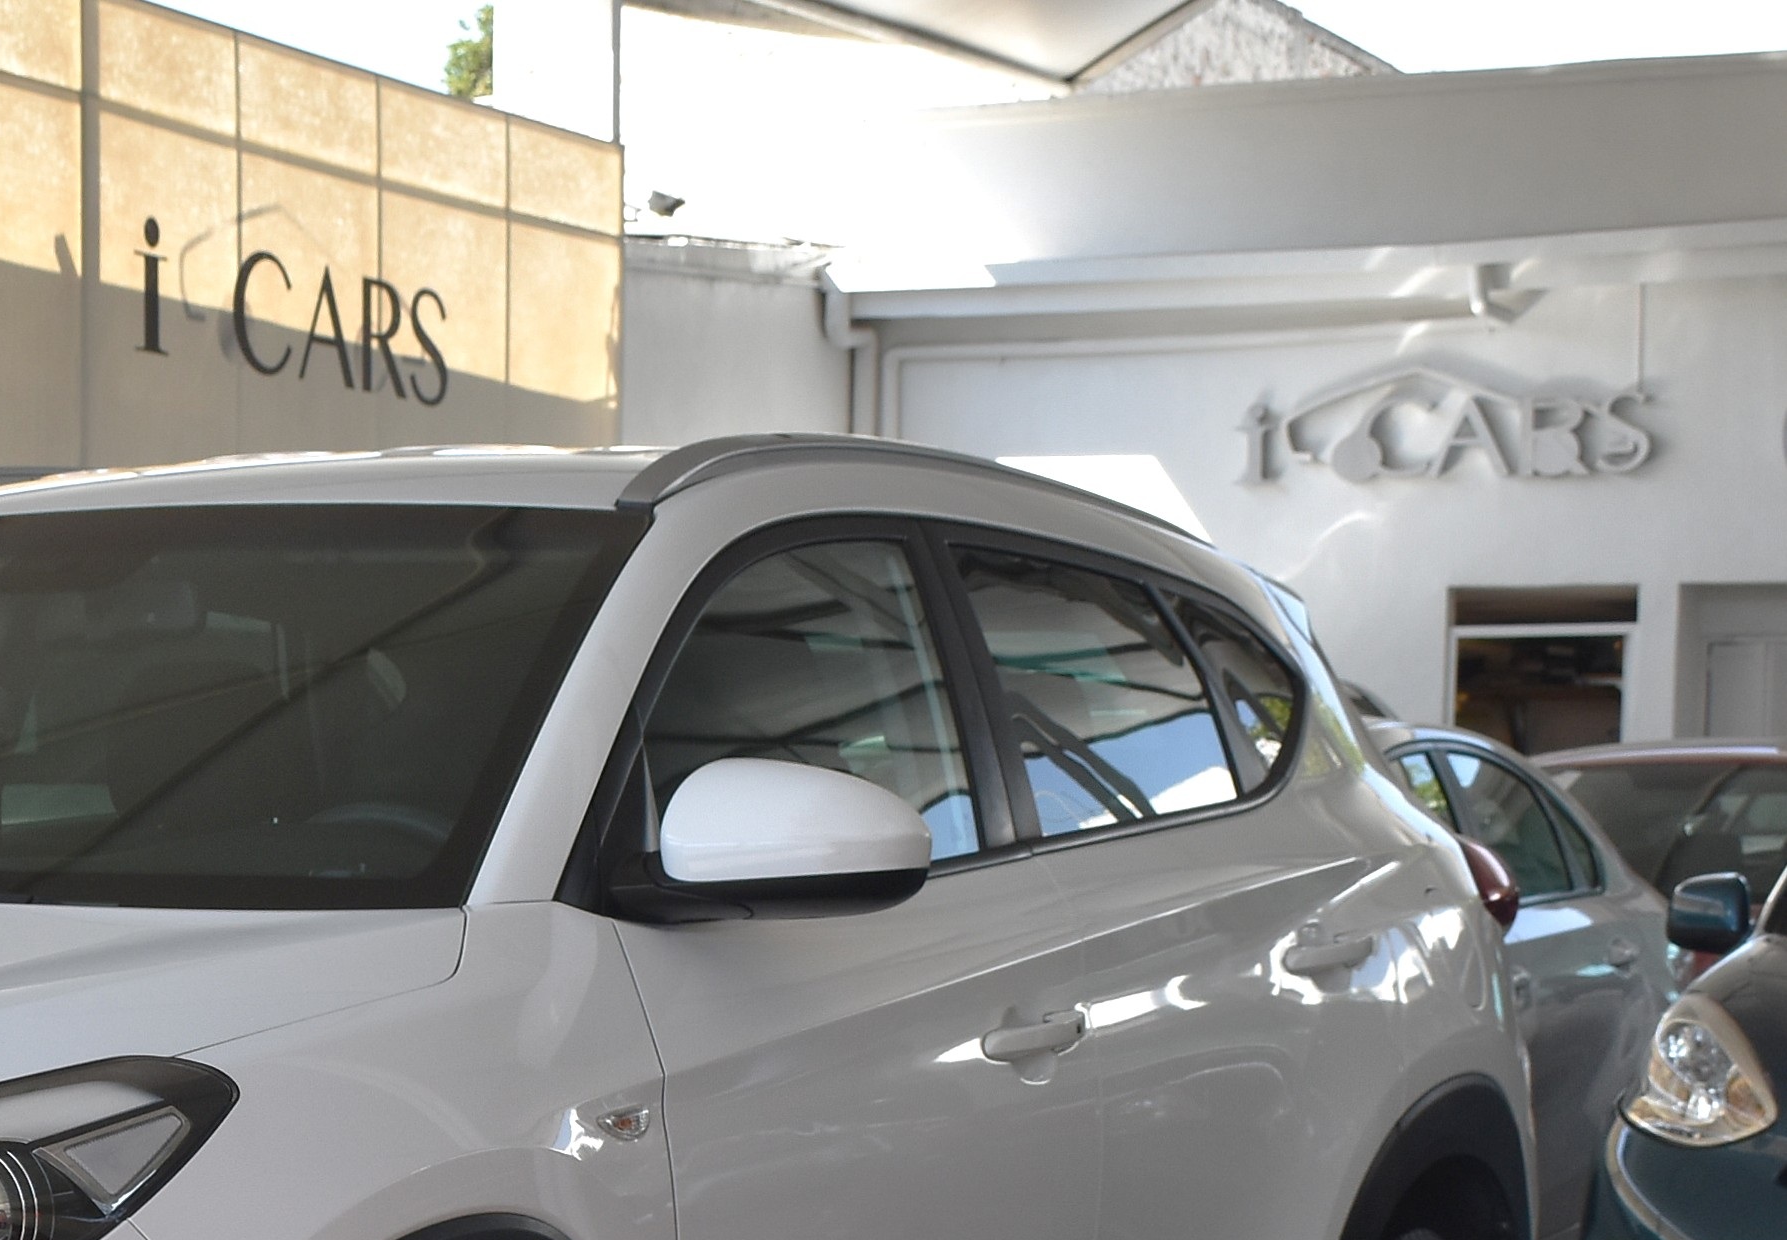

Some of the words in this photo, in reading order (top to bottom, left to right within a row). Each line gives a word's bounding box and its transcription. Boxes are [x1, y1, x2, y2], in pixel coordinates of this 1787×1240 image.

[134, 216, 168, 355] i
[234, 251, 448, 406] CARS
[1366, 388, 1654, 478] CARS
